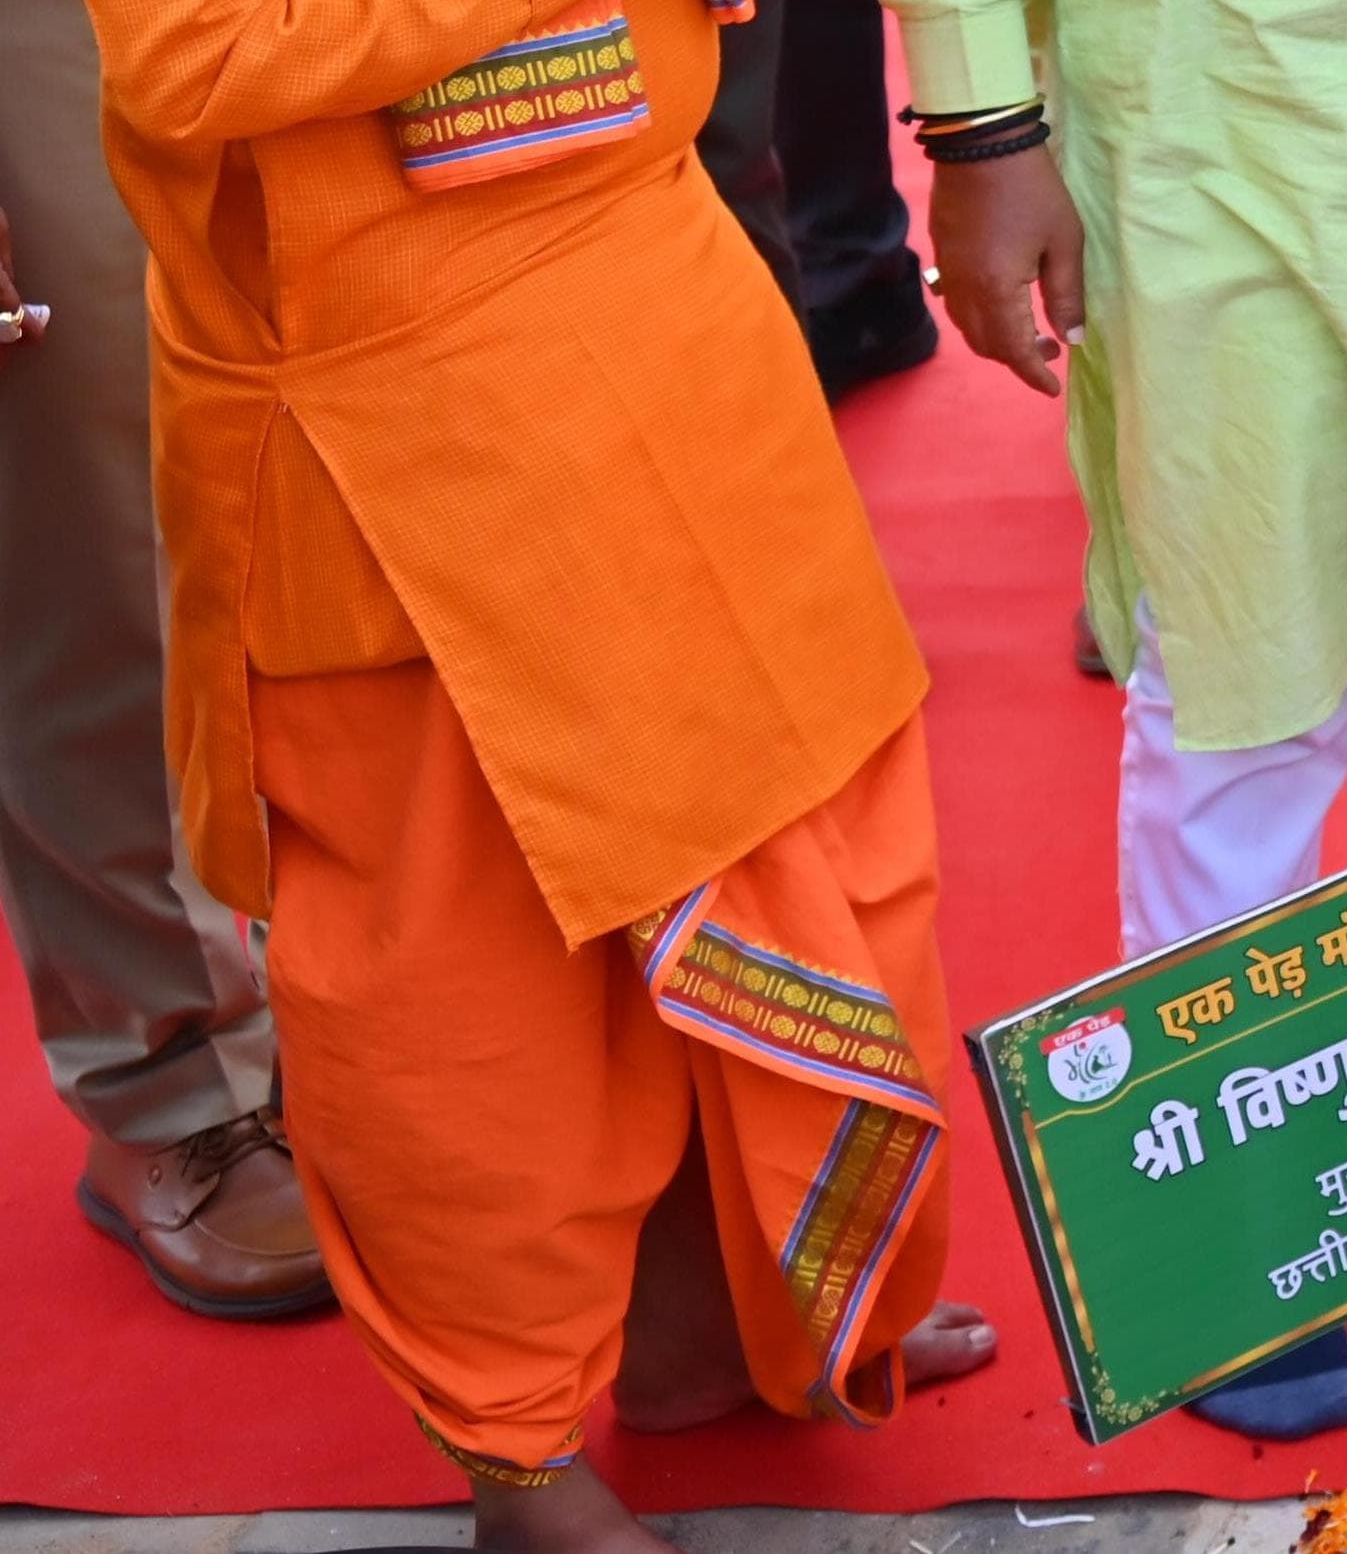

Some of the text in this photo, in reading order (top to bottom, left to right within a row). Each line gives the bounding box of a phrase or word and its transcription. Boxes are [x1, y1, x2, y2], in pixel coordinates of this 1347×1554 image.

[1156, 976, 1236, 1045] एक
[1245, 947, 1308, 999] पेड़
[1131, 1099, 1206, 1182] श्री
